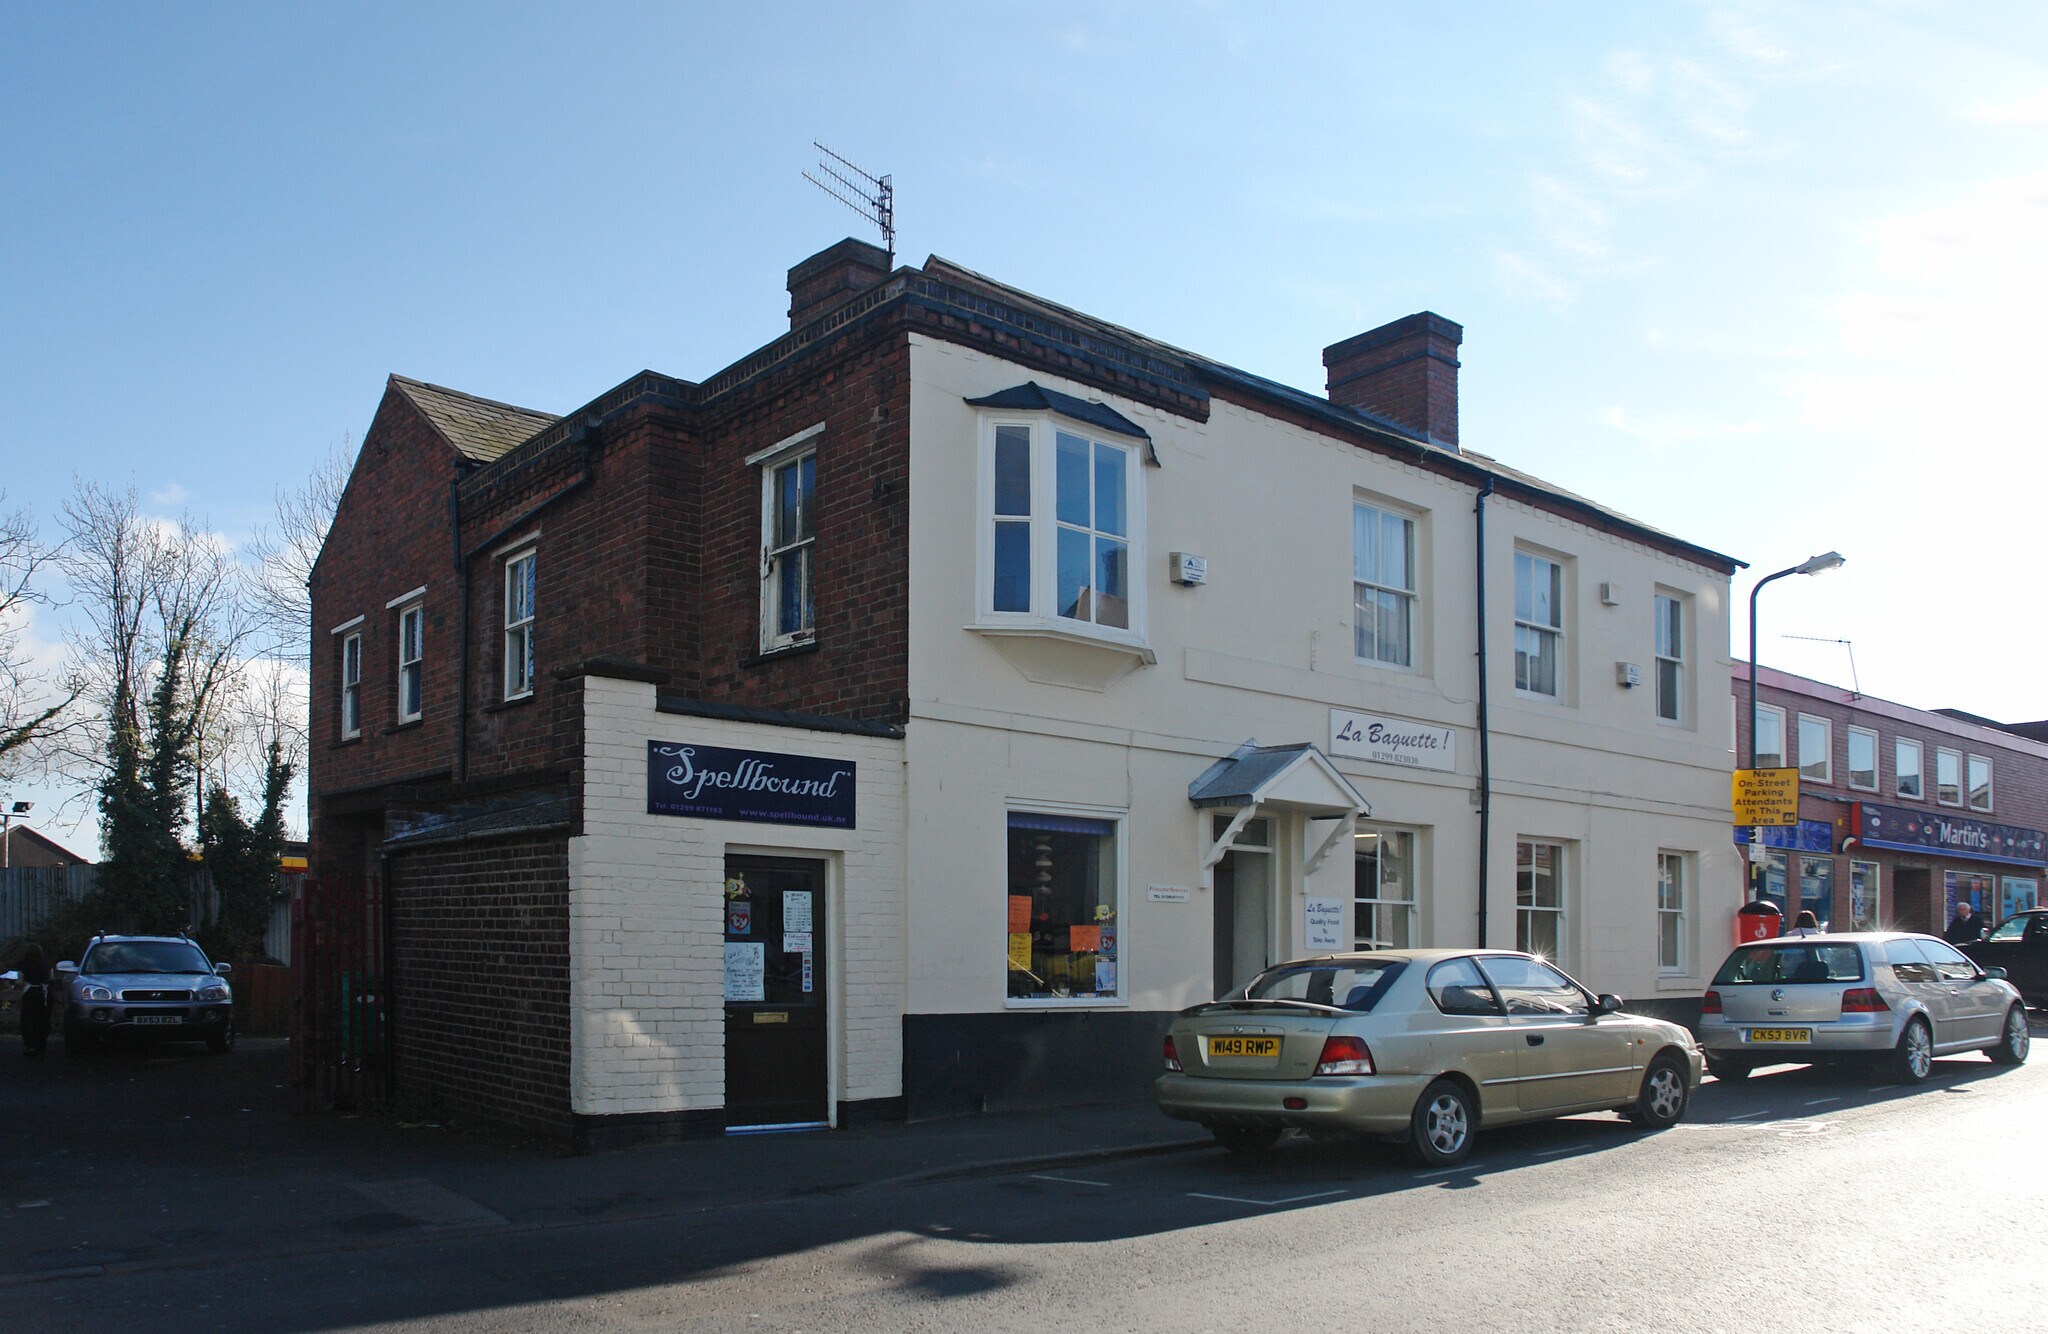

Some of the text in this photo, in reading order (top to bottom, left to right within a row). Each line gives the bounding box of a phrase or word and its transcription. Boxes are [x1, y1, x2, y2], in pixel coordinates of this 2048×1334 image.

[1336, 720, 1365, 742] La
[1368, 723, 1438, 752] Baguette
[1372, 751, 1393, 761] 01299
[659, 747, 846, 799] Spellbound
[1738, 779, 1791, 788] On-Street
[1744, 789, 1784, 797] Parking
[1735, 798, 1793, 806] Attendants
[670, 803, 694, 812] 01299
[1760, 807, 1781, 815] This
[1750, 816, 1775, 824] Area
[1940, 822, 1986, 848] Martin's
[1753, 1031, 1808, 1041] CK53 BVR
[1215, 1040, 1274, 1052] W149 RWP
